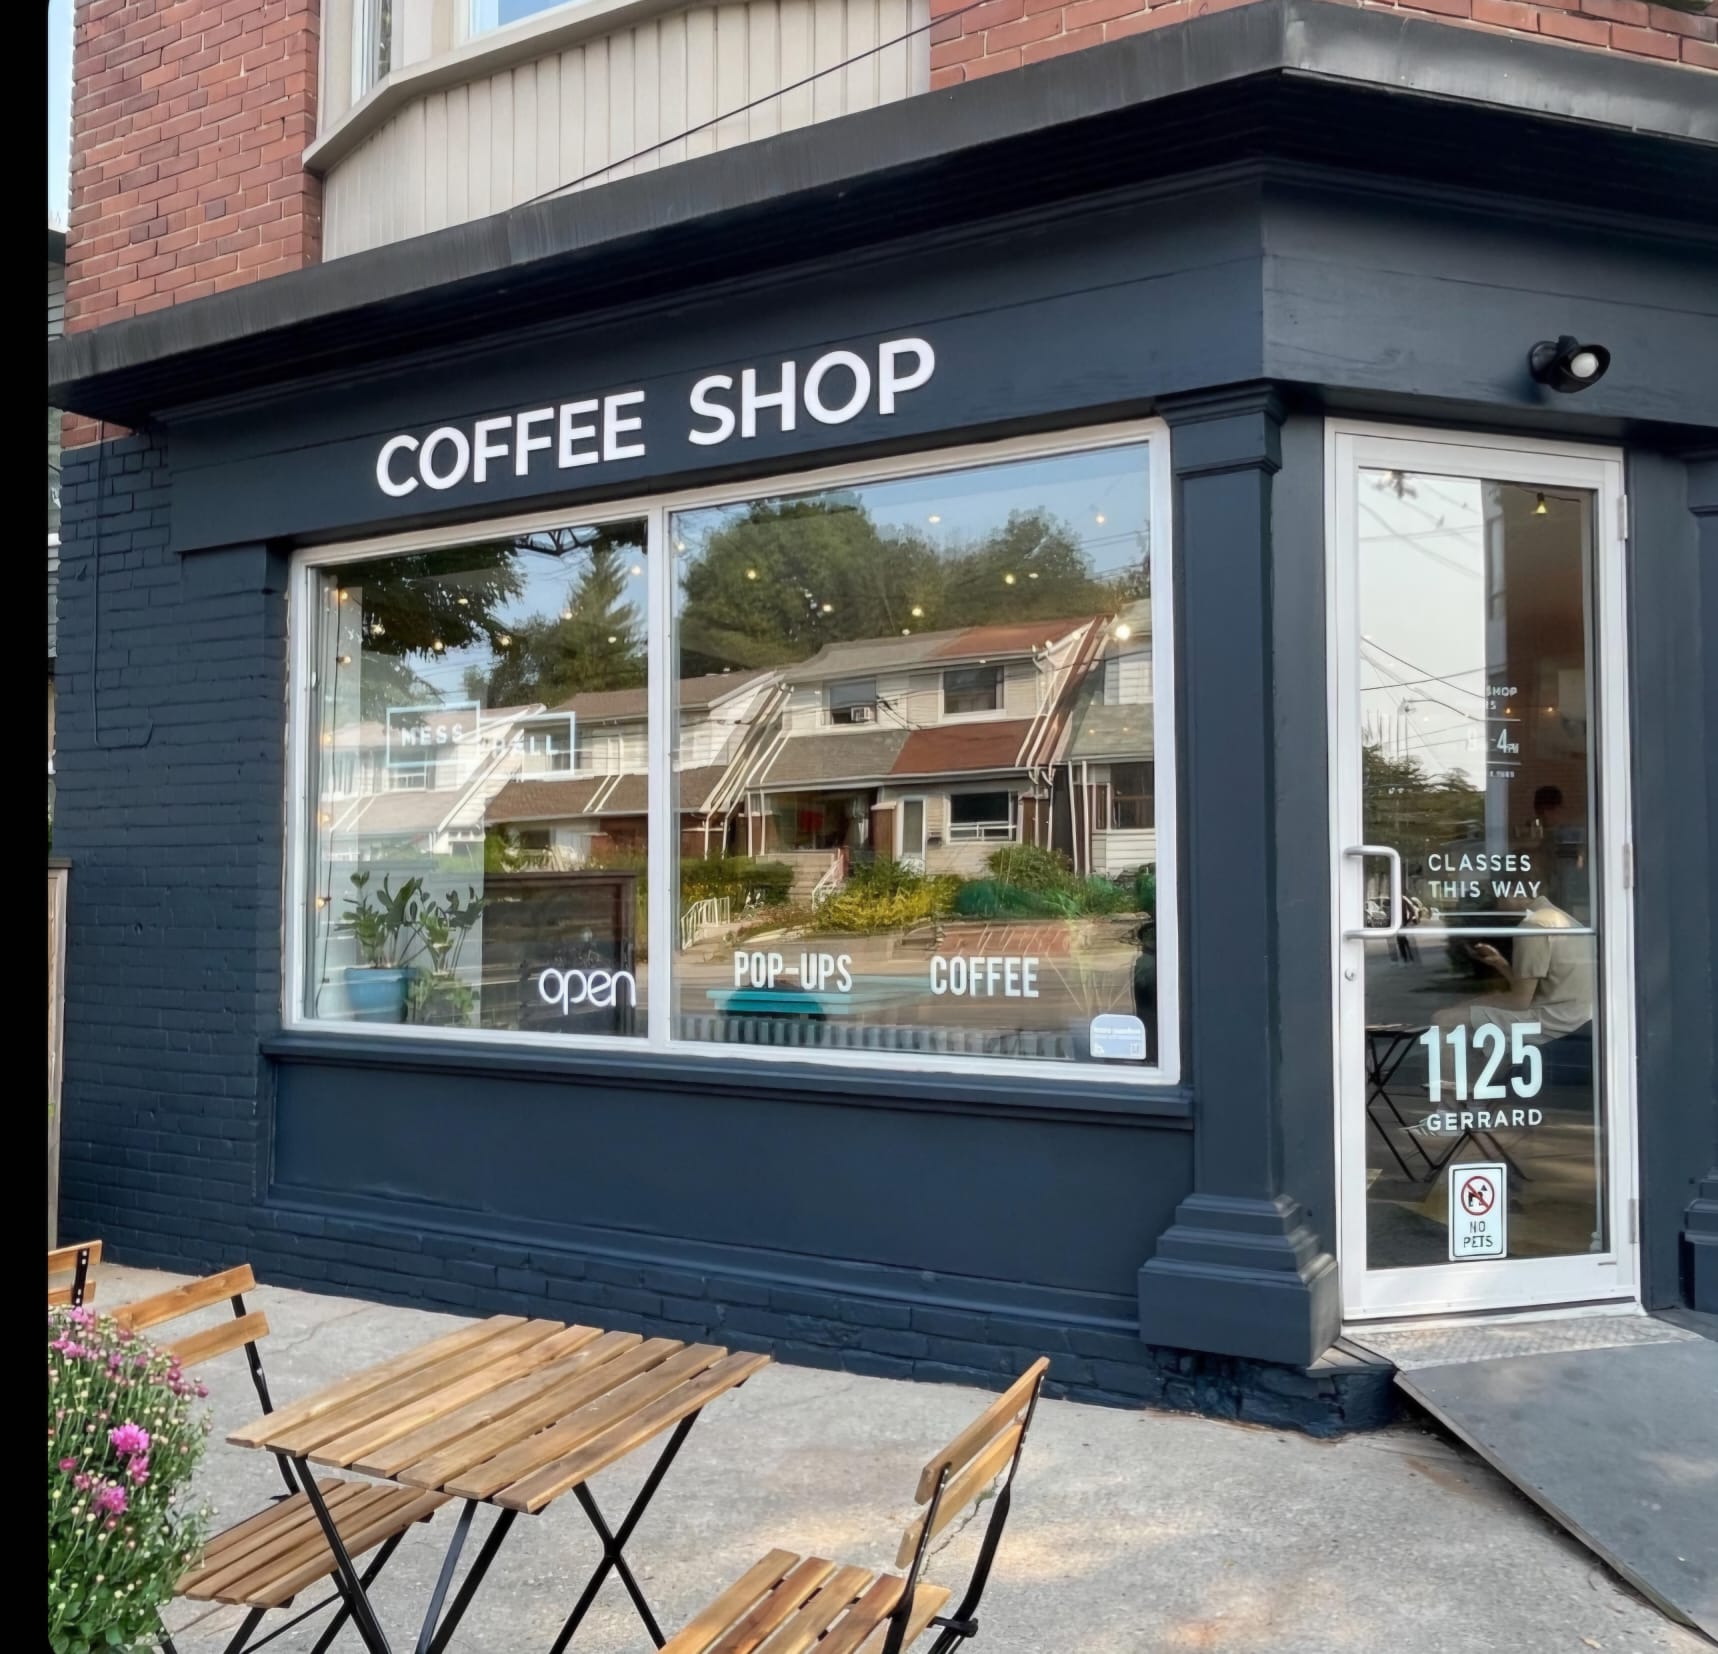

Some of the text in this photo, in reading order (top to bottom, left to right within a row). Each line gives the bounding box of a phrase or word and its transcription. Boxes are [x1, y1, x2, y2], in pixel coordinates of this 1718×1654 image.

[376, 337, 936, 498] COFFEE SHOP
[402, 723, 464, 747] MESS
[1428, 854, 1532, 872] CLASSES
[1428, 881, 1542, 898] THIS WAY
[734, 951, 853, 993] POP-UPS
[929, 955, 1040, 998] COFFEE
[538, 967, 637, 1016] open
[1419, 1022, 1543, 1103] 1125
[1427, 1108, 1543, 1132] GERRARD
[1469, 1221, 1486, 1233] NO
[1463, 1235, 1494, 1248] PETS
